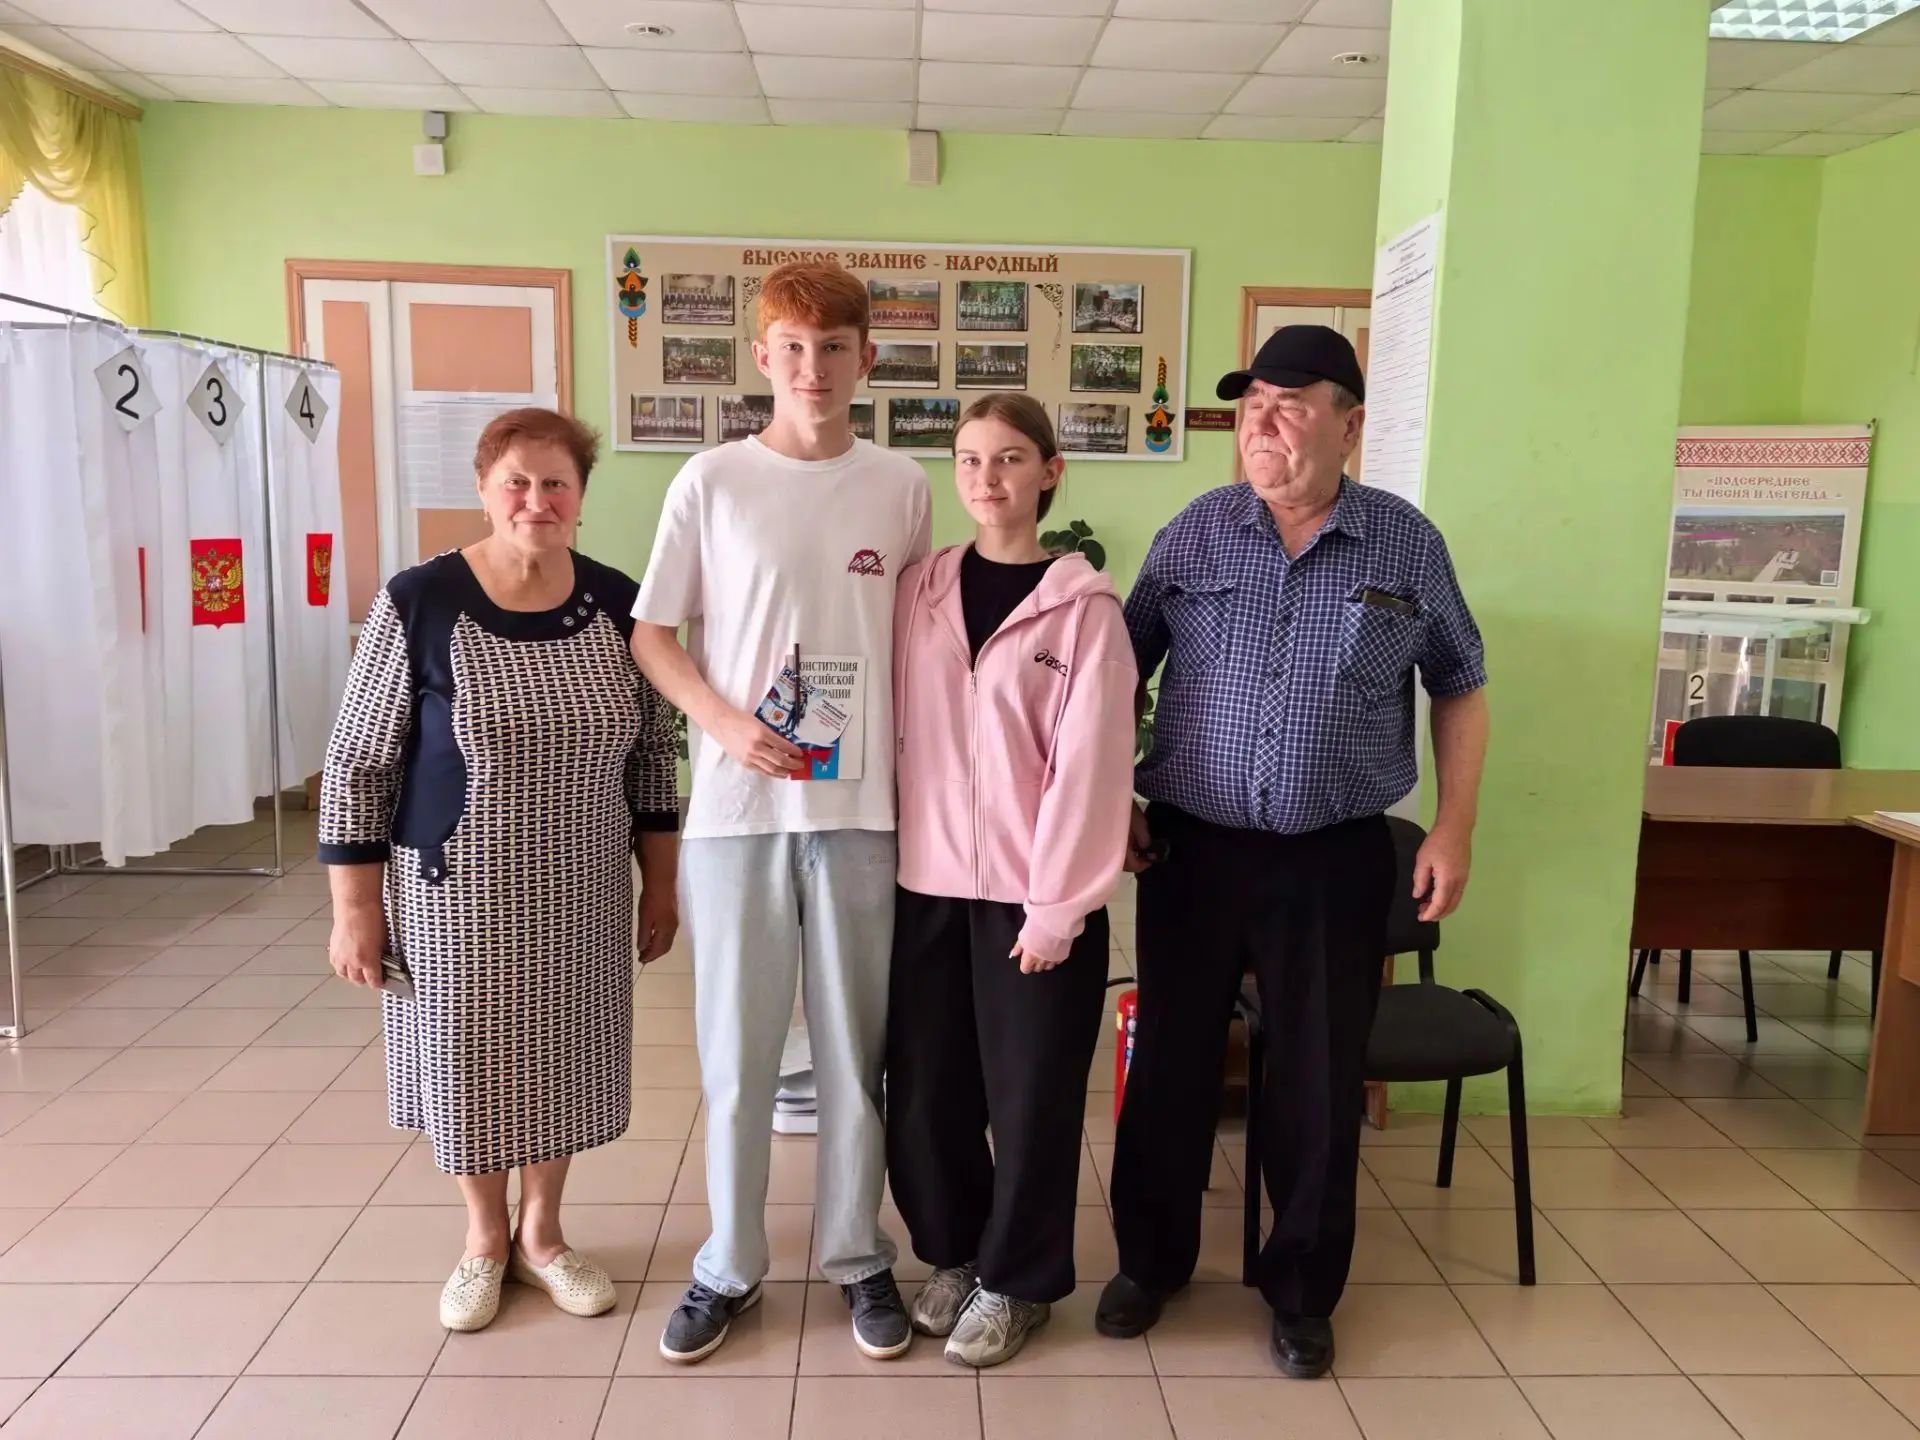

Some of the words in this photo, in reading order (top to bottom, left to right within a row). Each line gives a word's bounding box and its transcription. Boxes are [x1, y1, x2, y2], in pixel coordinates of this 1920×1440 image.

[845, 252, 926, 270] ЗВАНИЕ
[945, 253, 1059, 274] НАРОДНЫЙ
[115, 363, 139, 420] 2
[206, 377, 227, 426] 3
[300, 385, 315, 428] 4
[1682, 488, 1702, 498] ТЫ
[1706, 488, 1751, 498] ПЕСНЯ
[1754, 490, 1763, 498] И
[799, 661, 858, 672] ОНСТИТУЦИЯ
[800, 674, 855, 685] ОССИЙСКОЙ
[1690, 675, 1704, 700] 2
[818, 688, 851, 699] РАЦИИ
